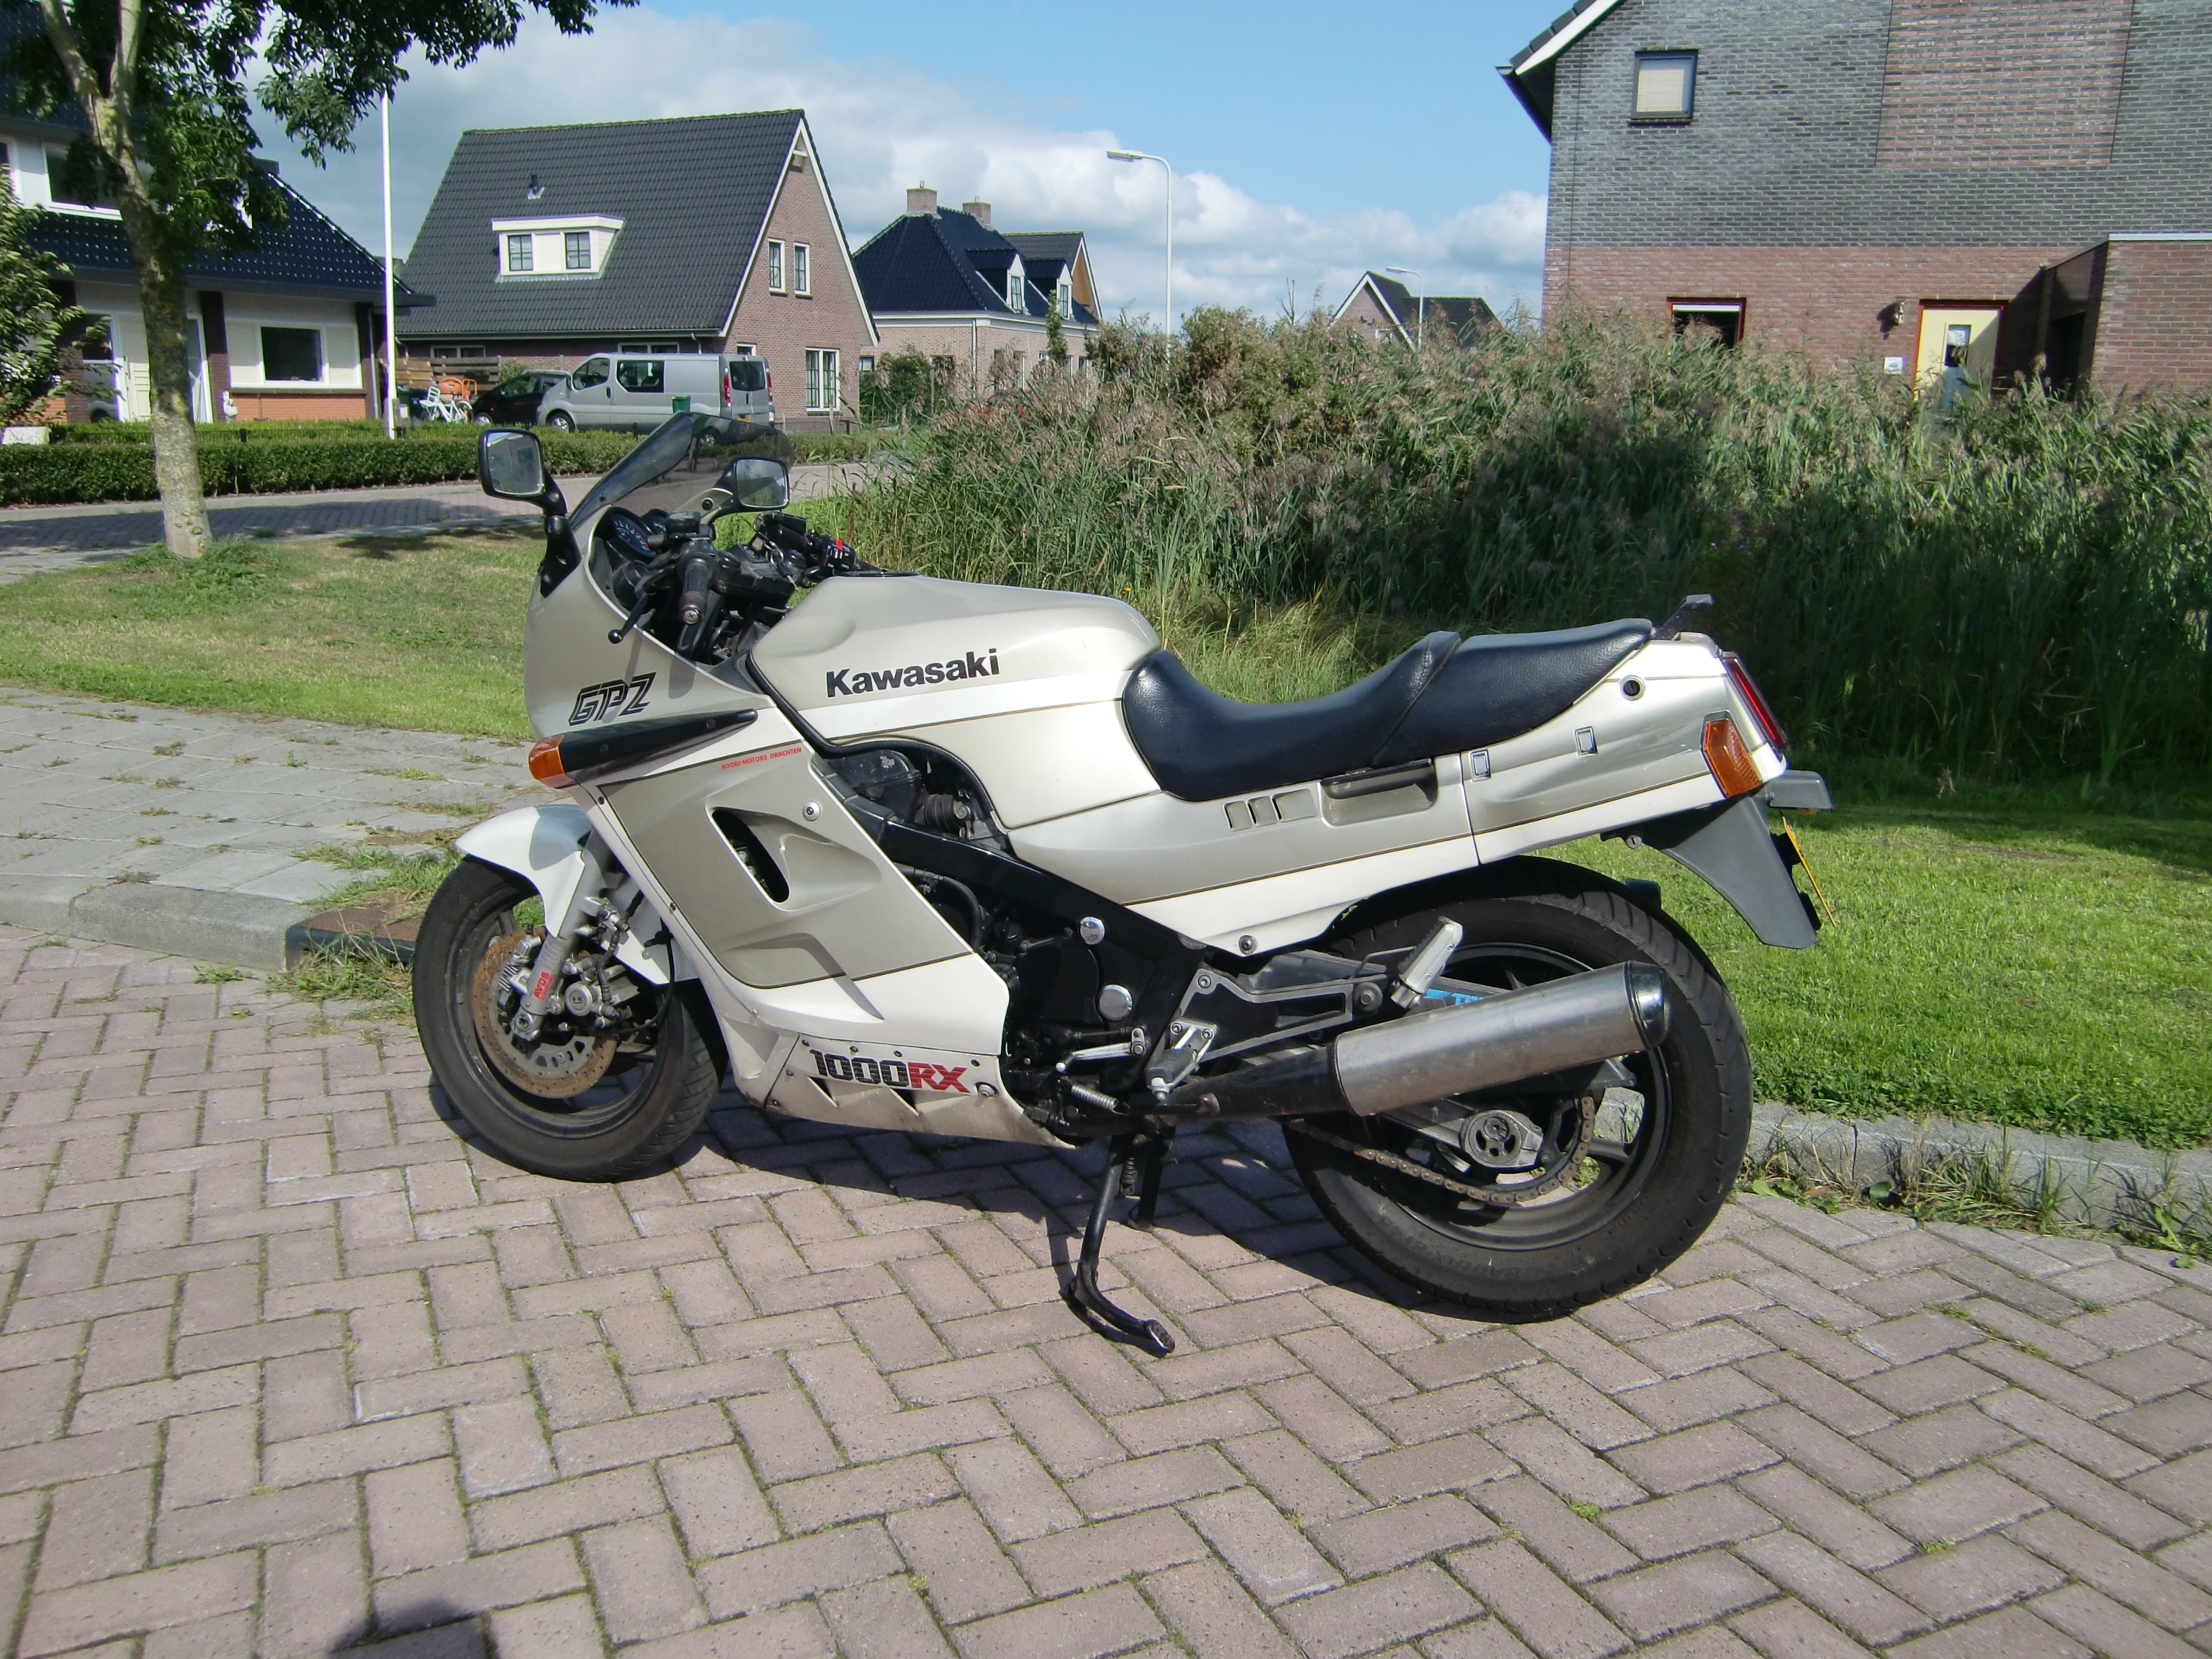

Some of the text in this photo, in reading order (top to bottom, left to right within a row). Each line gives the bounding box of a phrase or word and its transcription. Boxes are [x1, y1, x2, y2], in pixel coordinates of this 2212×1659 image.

[826, 647, 1000, 698] Kawasaki
[568, 671, 657, 727] GPZ
[721, 747, 801, 770] NOORD MOTORS DRACHTEN
[809, 1048, 972, 1094] 1000RX
